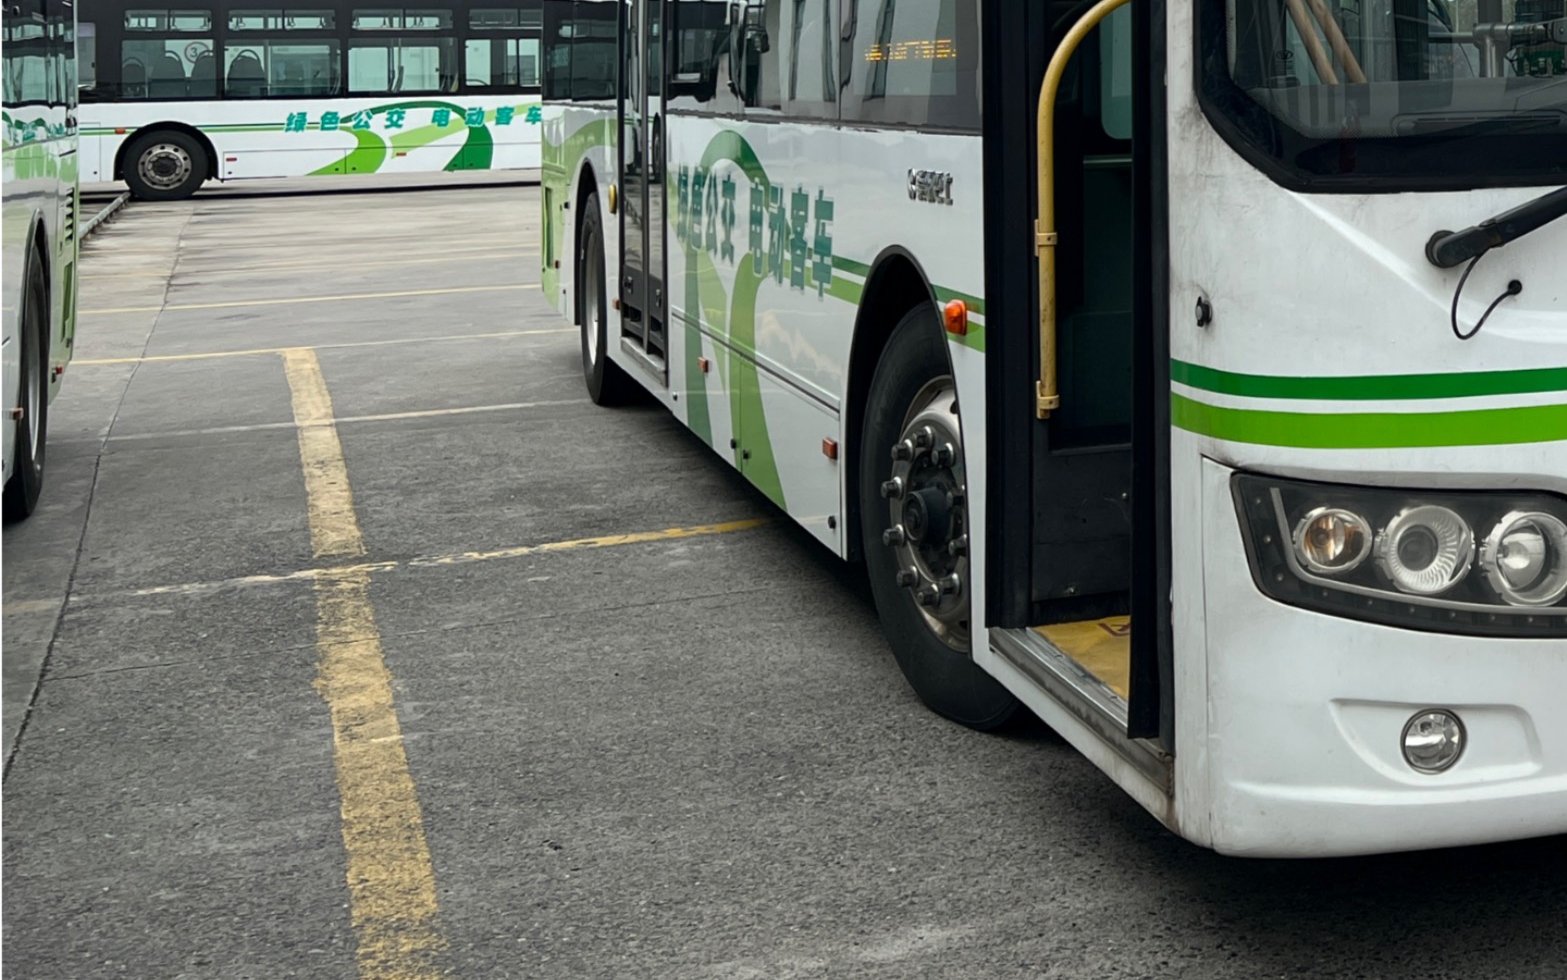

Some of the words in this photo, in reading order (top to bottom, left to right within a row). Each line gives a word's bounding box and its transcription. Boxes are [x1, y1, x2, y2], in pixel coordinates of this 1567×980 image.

[284, 108, 407, 132] 绿色公交
[432, 106, 541, 127] 电动客车
[749, 177, 835, 302] 电动客车
